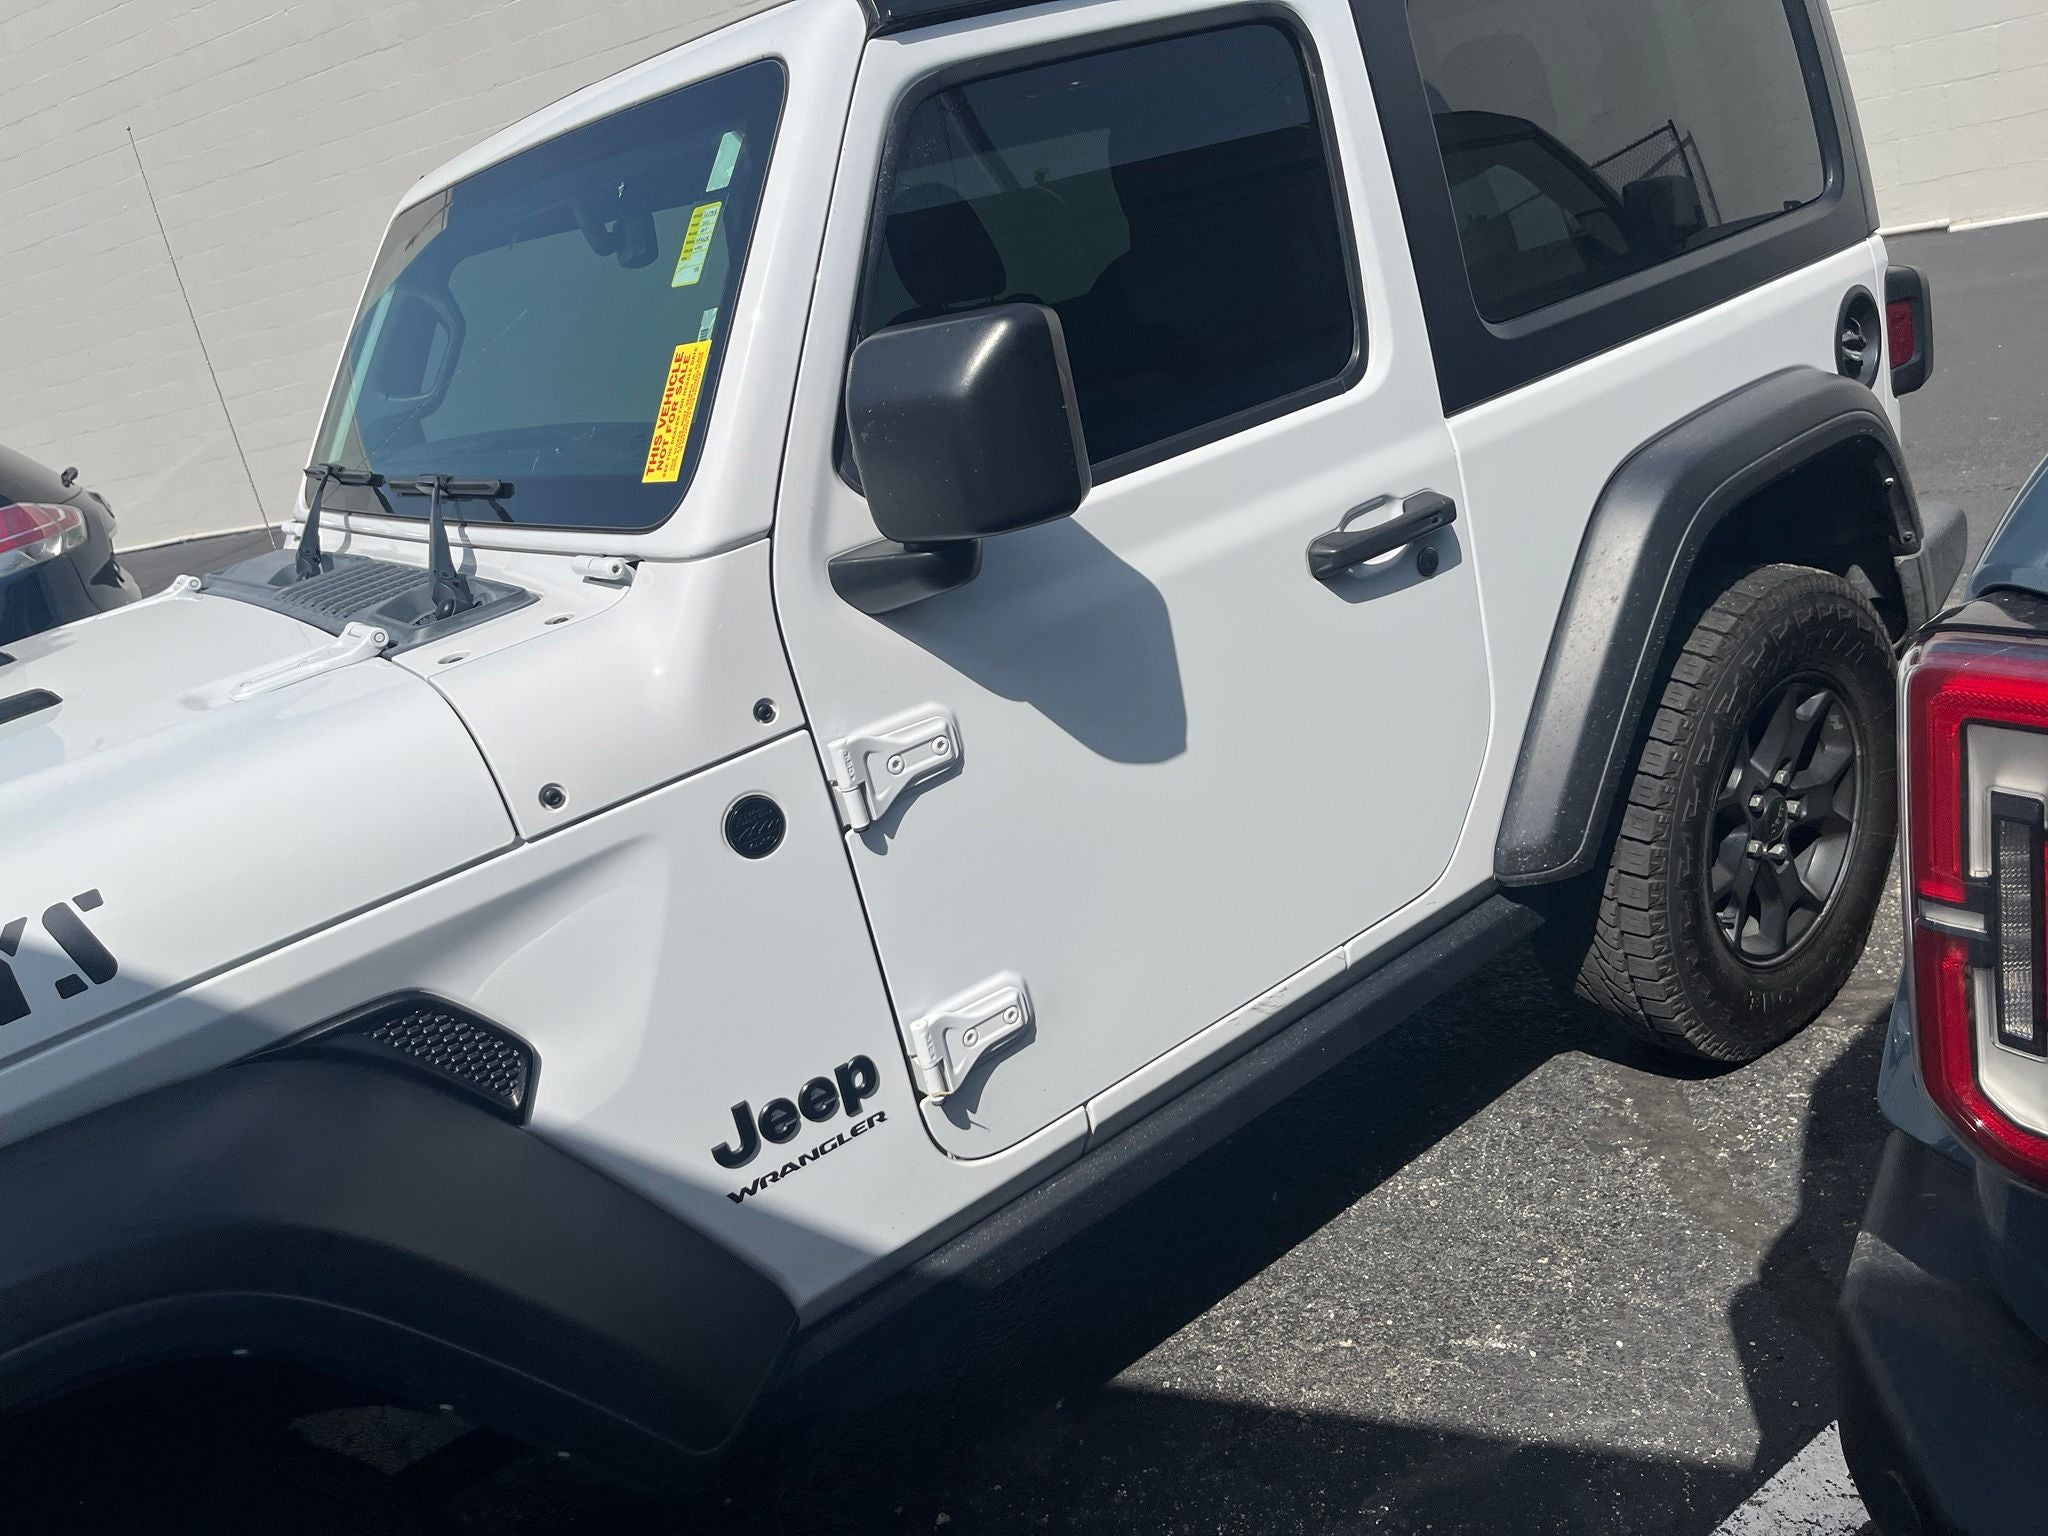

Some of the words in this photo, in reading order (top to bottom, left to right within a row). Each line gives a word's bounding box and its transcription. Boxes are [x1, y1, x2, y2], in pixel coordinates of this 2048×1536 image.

[645, 434, 663, 476] THIS
[658, 351, 684, 429] VEHICLE
[656, 438, 669, 470] NOT
[665, 401, 679, 433] FOR
[675, 354, 691, 395] SALE
[665, 446, 673, 461] THE
[669, 414, 681, 445] DEALER
[677, 397, 685, 413] FOR
[711, 1054, 881, 1169] Jeep
[726, 1111, 889, 1204] WRANGLER
